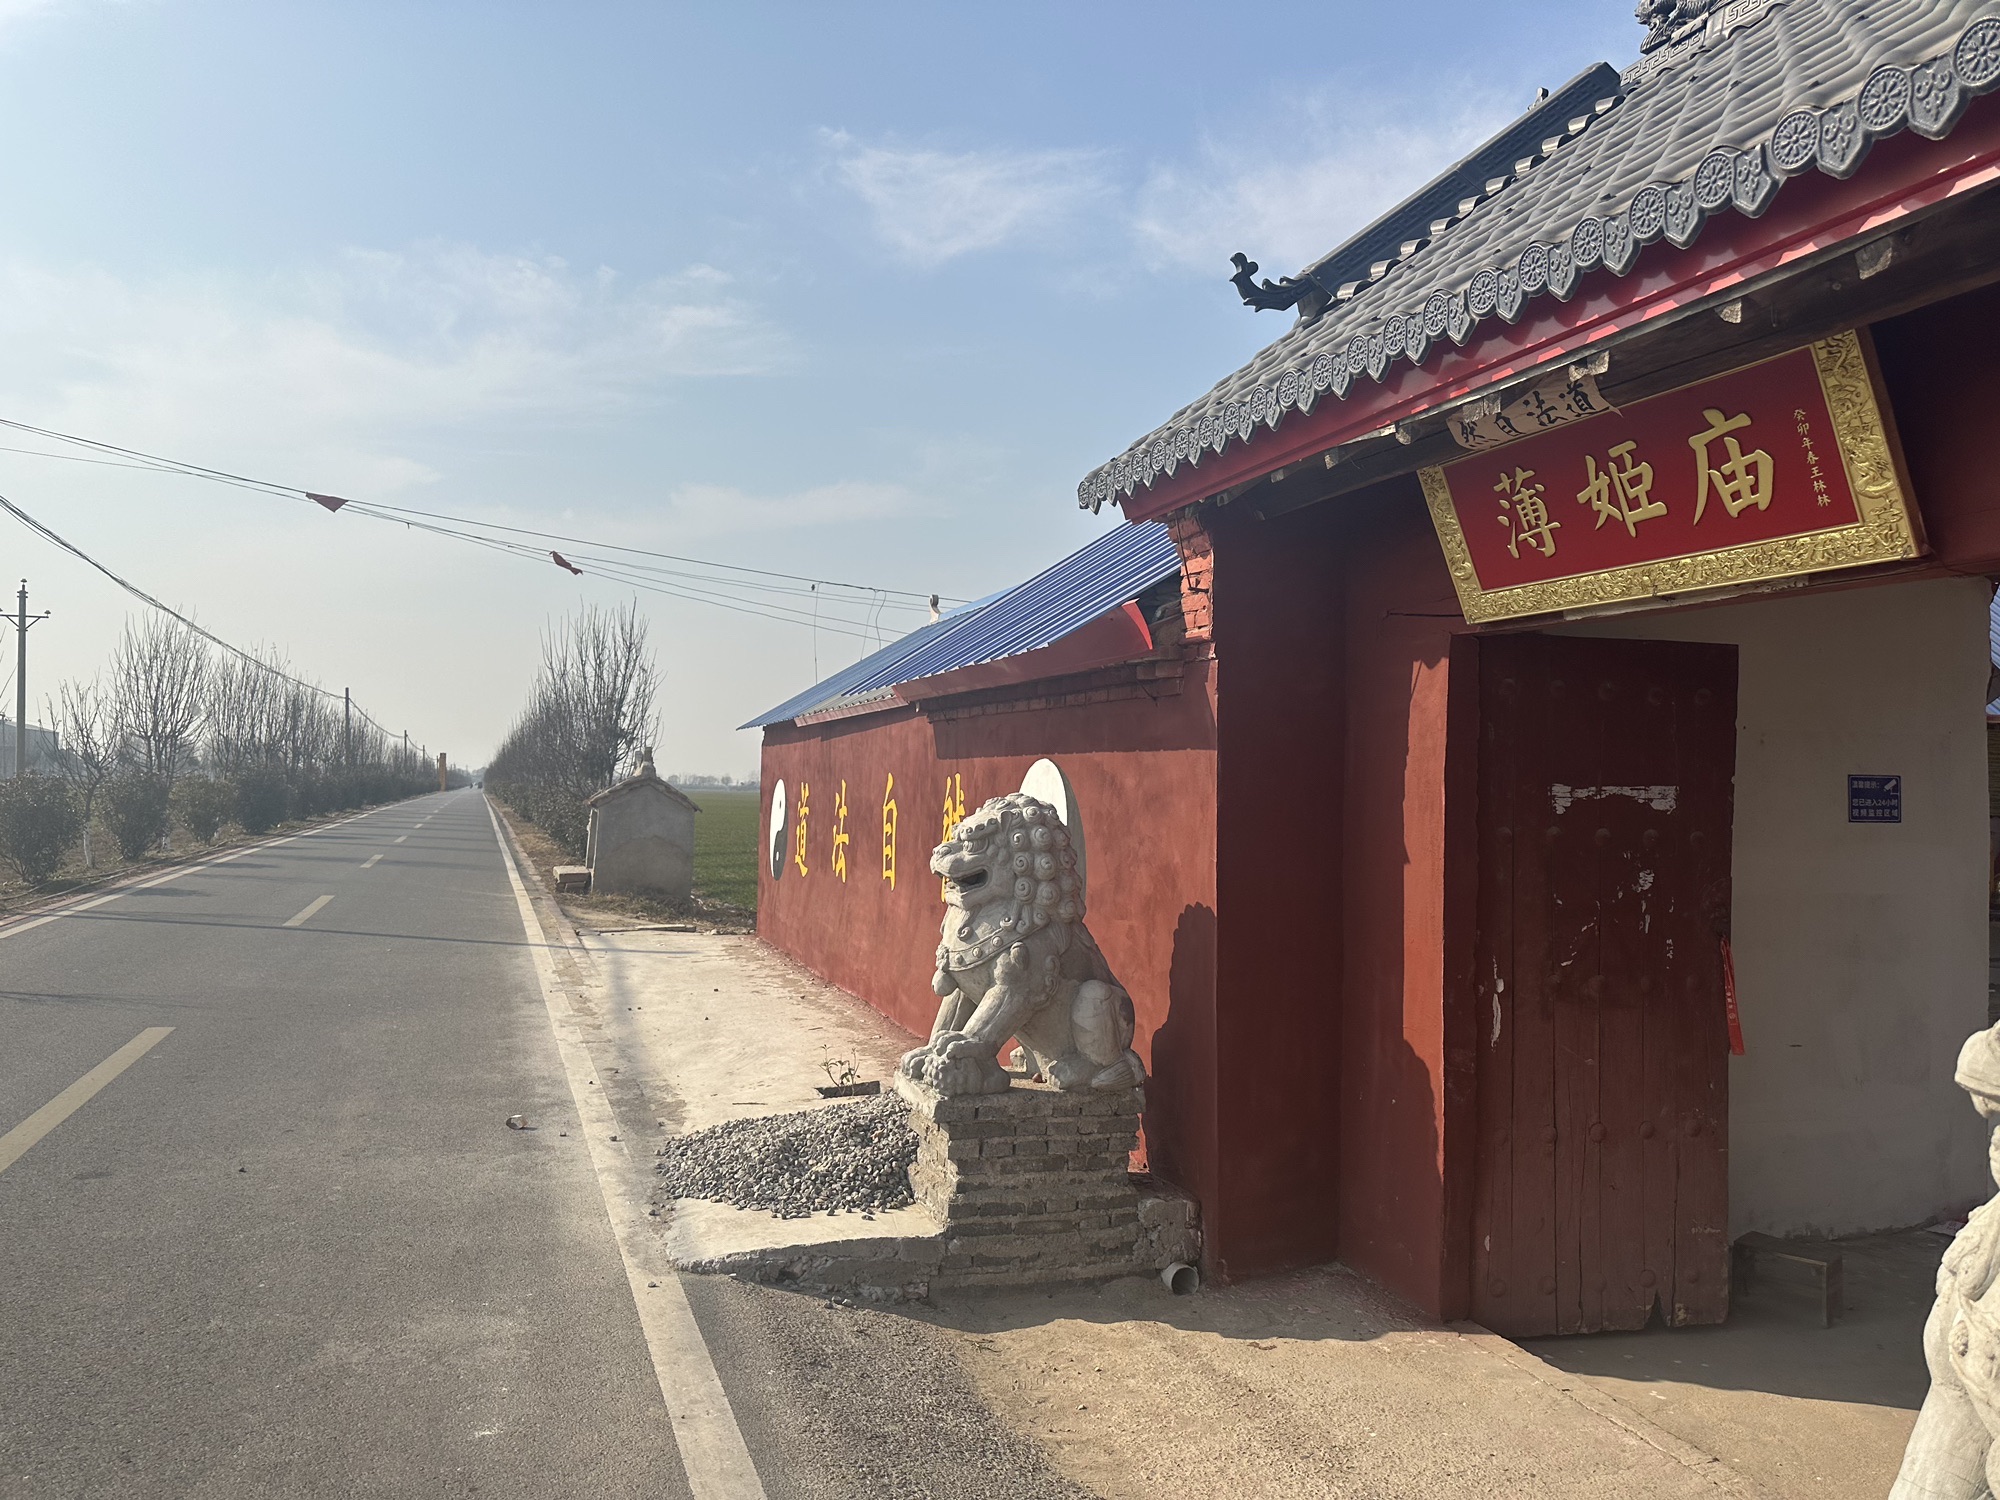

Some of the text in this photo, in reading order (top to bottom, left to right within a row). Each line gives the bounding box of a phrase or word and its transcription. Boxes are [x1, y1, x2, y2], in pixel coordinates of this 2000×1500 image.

[1459, 380, 1610, 448] 道法自然
[1793, 408, 1831, 507] 癸卯年春王林林
[1493, 408, 1775, 559] 薄姬庙
